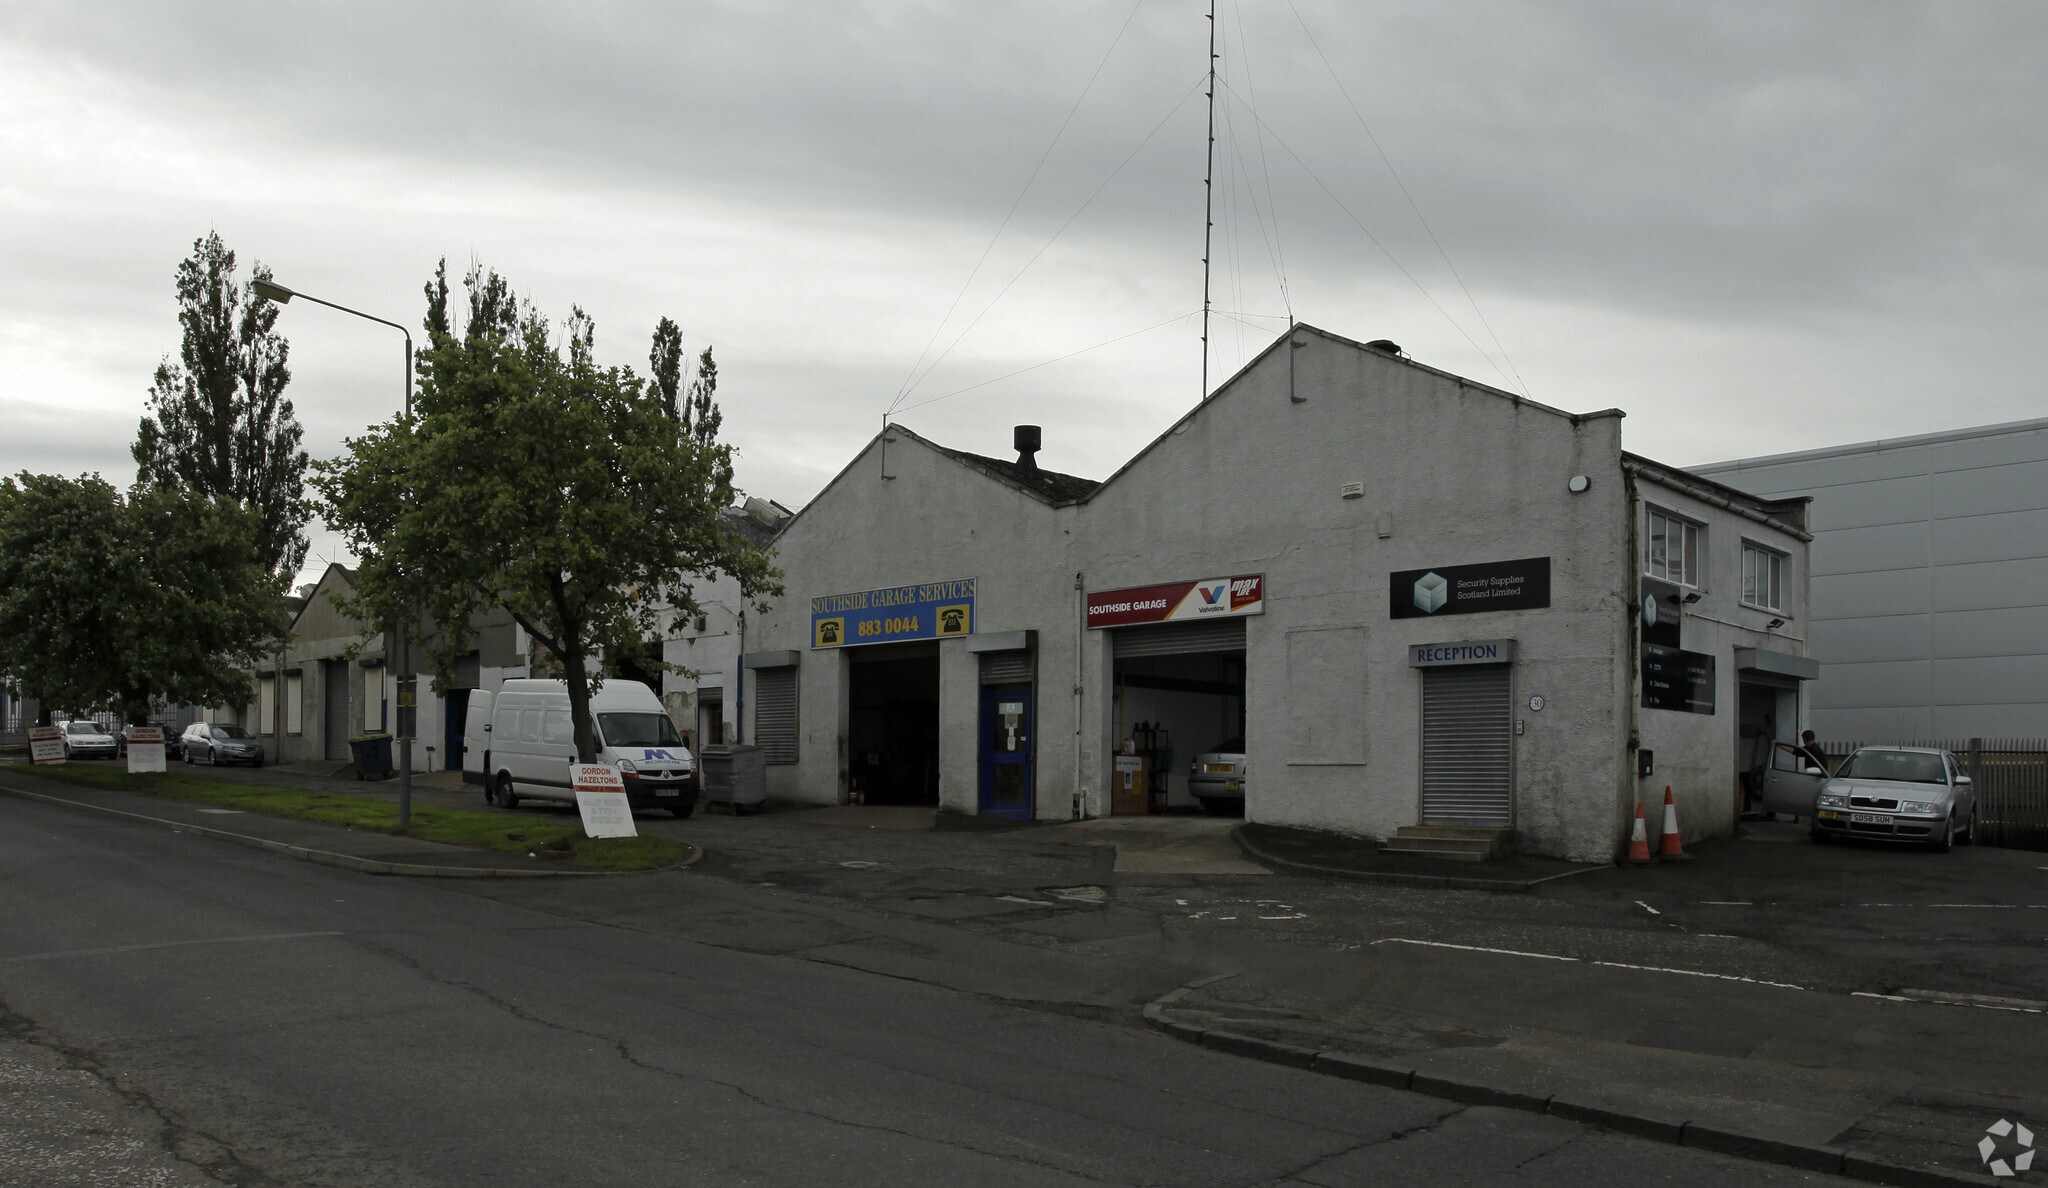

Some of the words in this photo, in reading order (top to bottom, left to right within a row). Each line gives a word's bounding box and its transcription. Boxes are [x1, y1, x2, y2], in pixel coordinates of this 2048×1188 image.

[1457, 578, 1489, 589] Security
[1490, 575, 1525, 586] Supplies
[811, 592, 869, 614] SOUTHSIDE
[871, 586, 916, 608] GARAGE
[919, 580, 975, 603] SERVICES
[1457, 590, 1490, 600] Scotland
[1491, 586, 1521, 597] Limited
[1088, 602, 1131, 615] SOUTHSIDE
[1133, 599, 1167, 611] GARAGE
[1198, 605, 1225, 613] Valvoline
[858, 619, 882, 636] 883
[885, 615, 919, 634] 0044
[1418, 644, 1497, 662] RECEPTION
[1532, 698, 1543, 708] 30
[581, 767, 611, 775] GORDON
[578, 776, 619, 784] HAZELTONS
[1875, 815, 1890, 823] SUH
